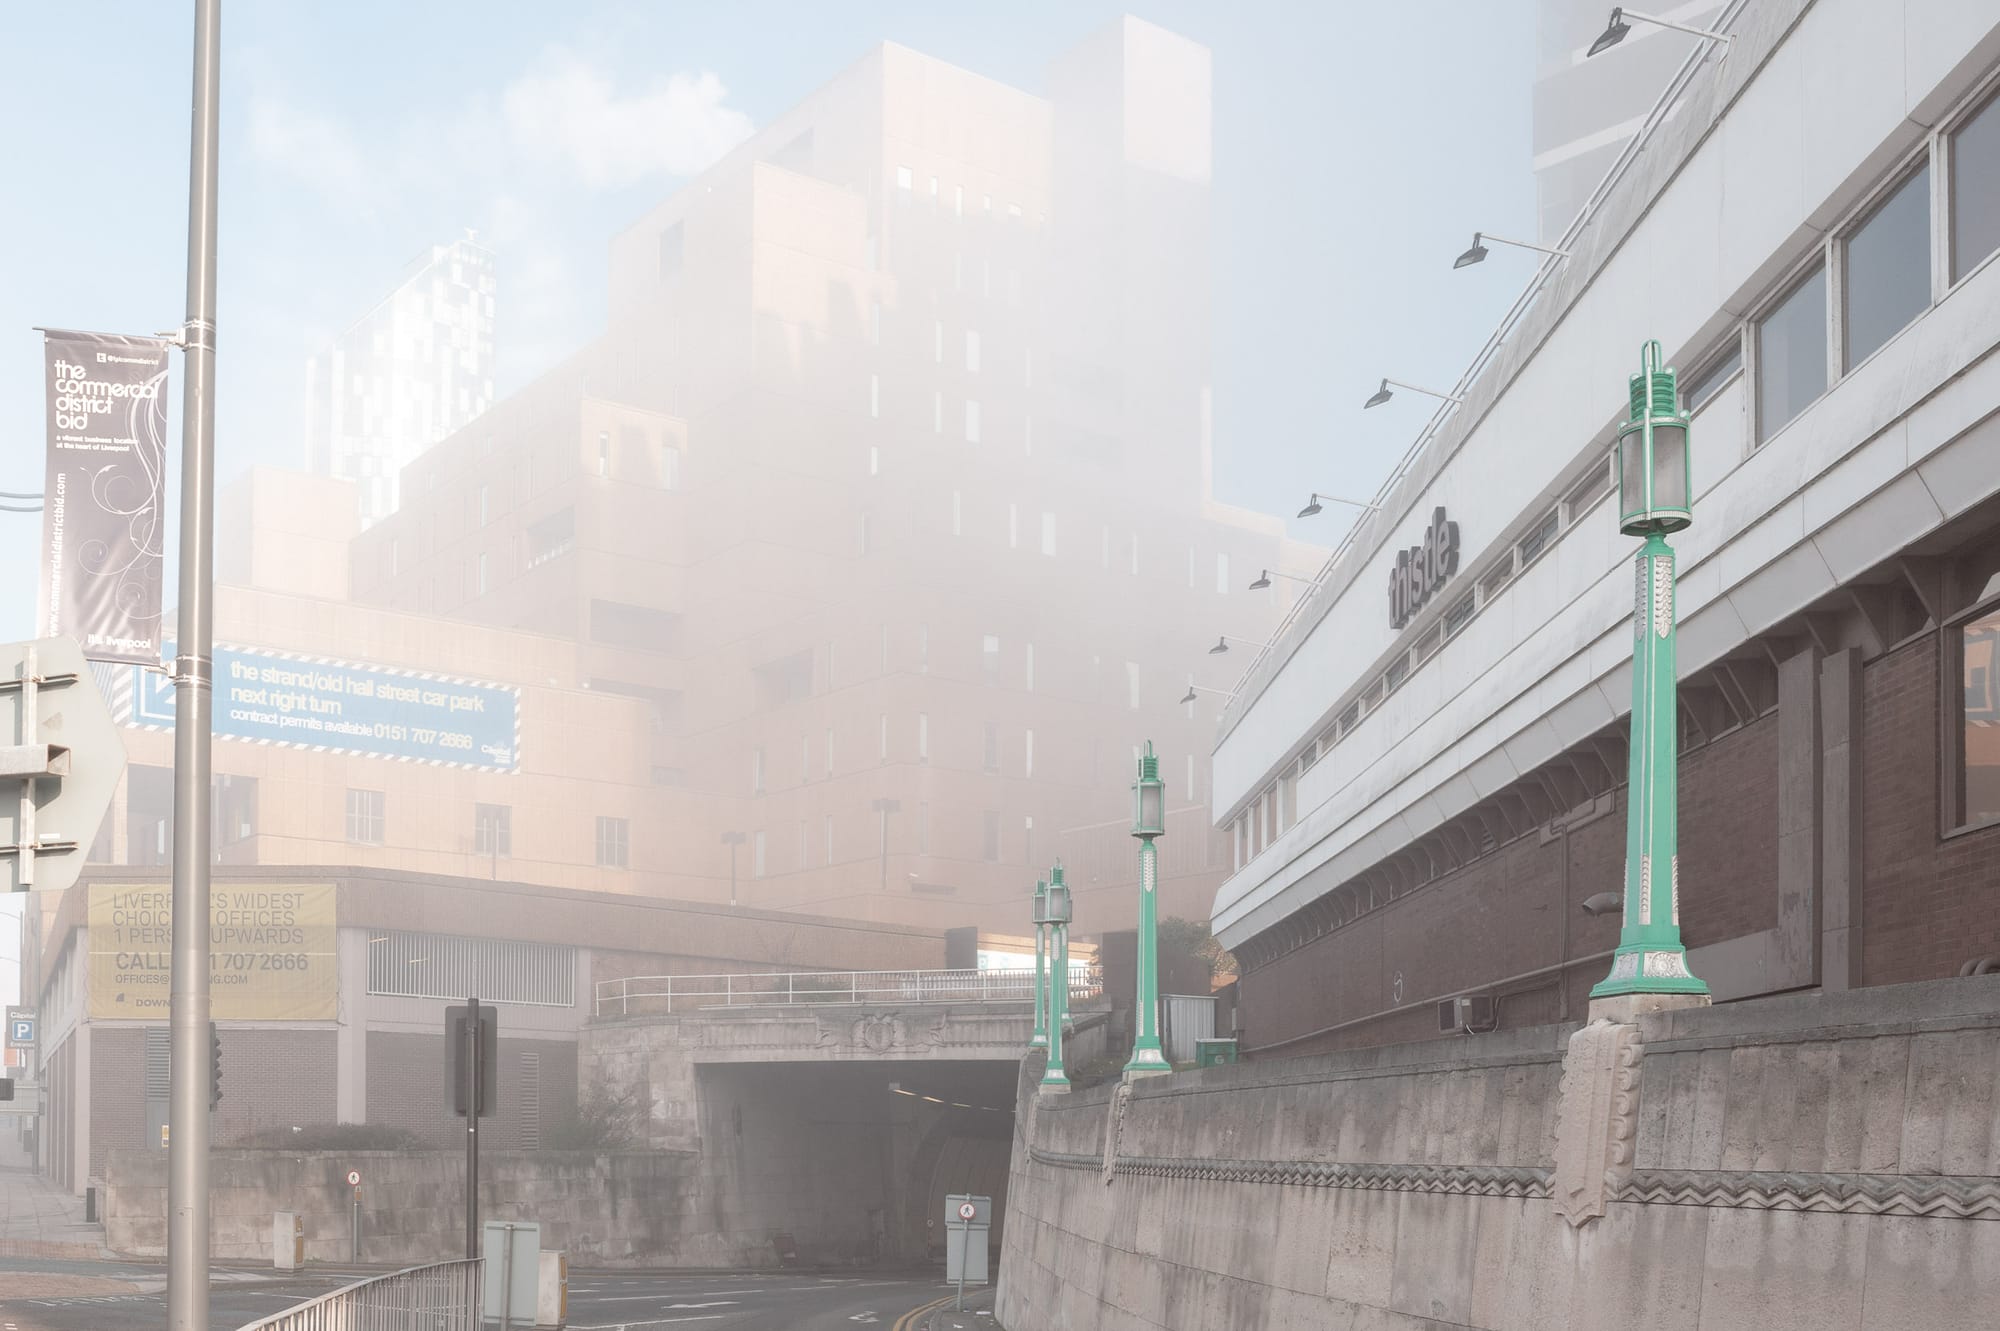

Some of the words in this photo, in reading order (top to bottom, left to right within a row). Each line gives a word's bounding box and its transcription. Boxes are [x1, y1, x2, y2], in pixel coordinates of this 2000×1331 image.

[54, 359, 86, 380] the
[55, 378, 159, 400] commercial
[56, 394, 113, 414] district
[56, 411, 88, 430] bid
[1388, 505, 1460, 629] thistle
[230, 661, 259, 681] the
[261, 667, 343, 693] strand/old
[345, 677, 373, 698] hall
[376, 683, 420, 704] street
[422, 690, 449, 707] car
[449, 695, 485, 713] park
[230, 688, 266, 705] next
[270, 690, 306, 713] right
[309, 696, 342, 716] turn
[230, 709, 278, 725] contract
[279, 714, 322, 730] permits
[324, 721, 373, 737] available
[374, 723, 407, 741] 0151
[411, 727, 437, 745] 707
[438, 732, 473, 749] 2666
[234, 893, 305, 909] WIDEST
[112, 911, 169, 927] CHOIC
[216, 911, 295, 927] OFFICES
[114, 929, 122, 944] 1
[129, 929, 171, 944] PER
[211, 928, 304, 945] UPWARDS
[115, 953, 171, 970] CALL
[223, 955, 257, 971] 707
[259, 954, 309, 971] 2666
